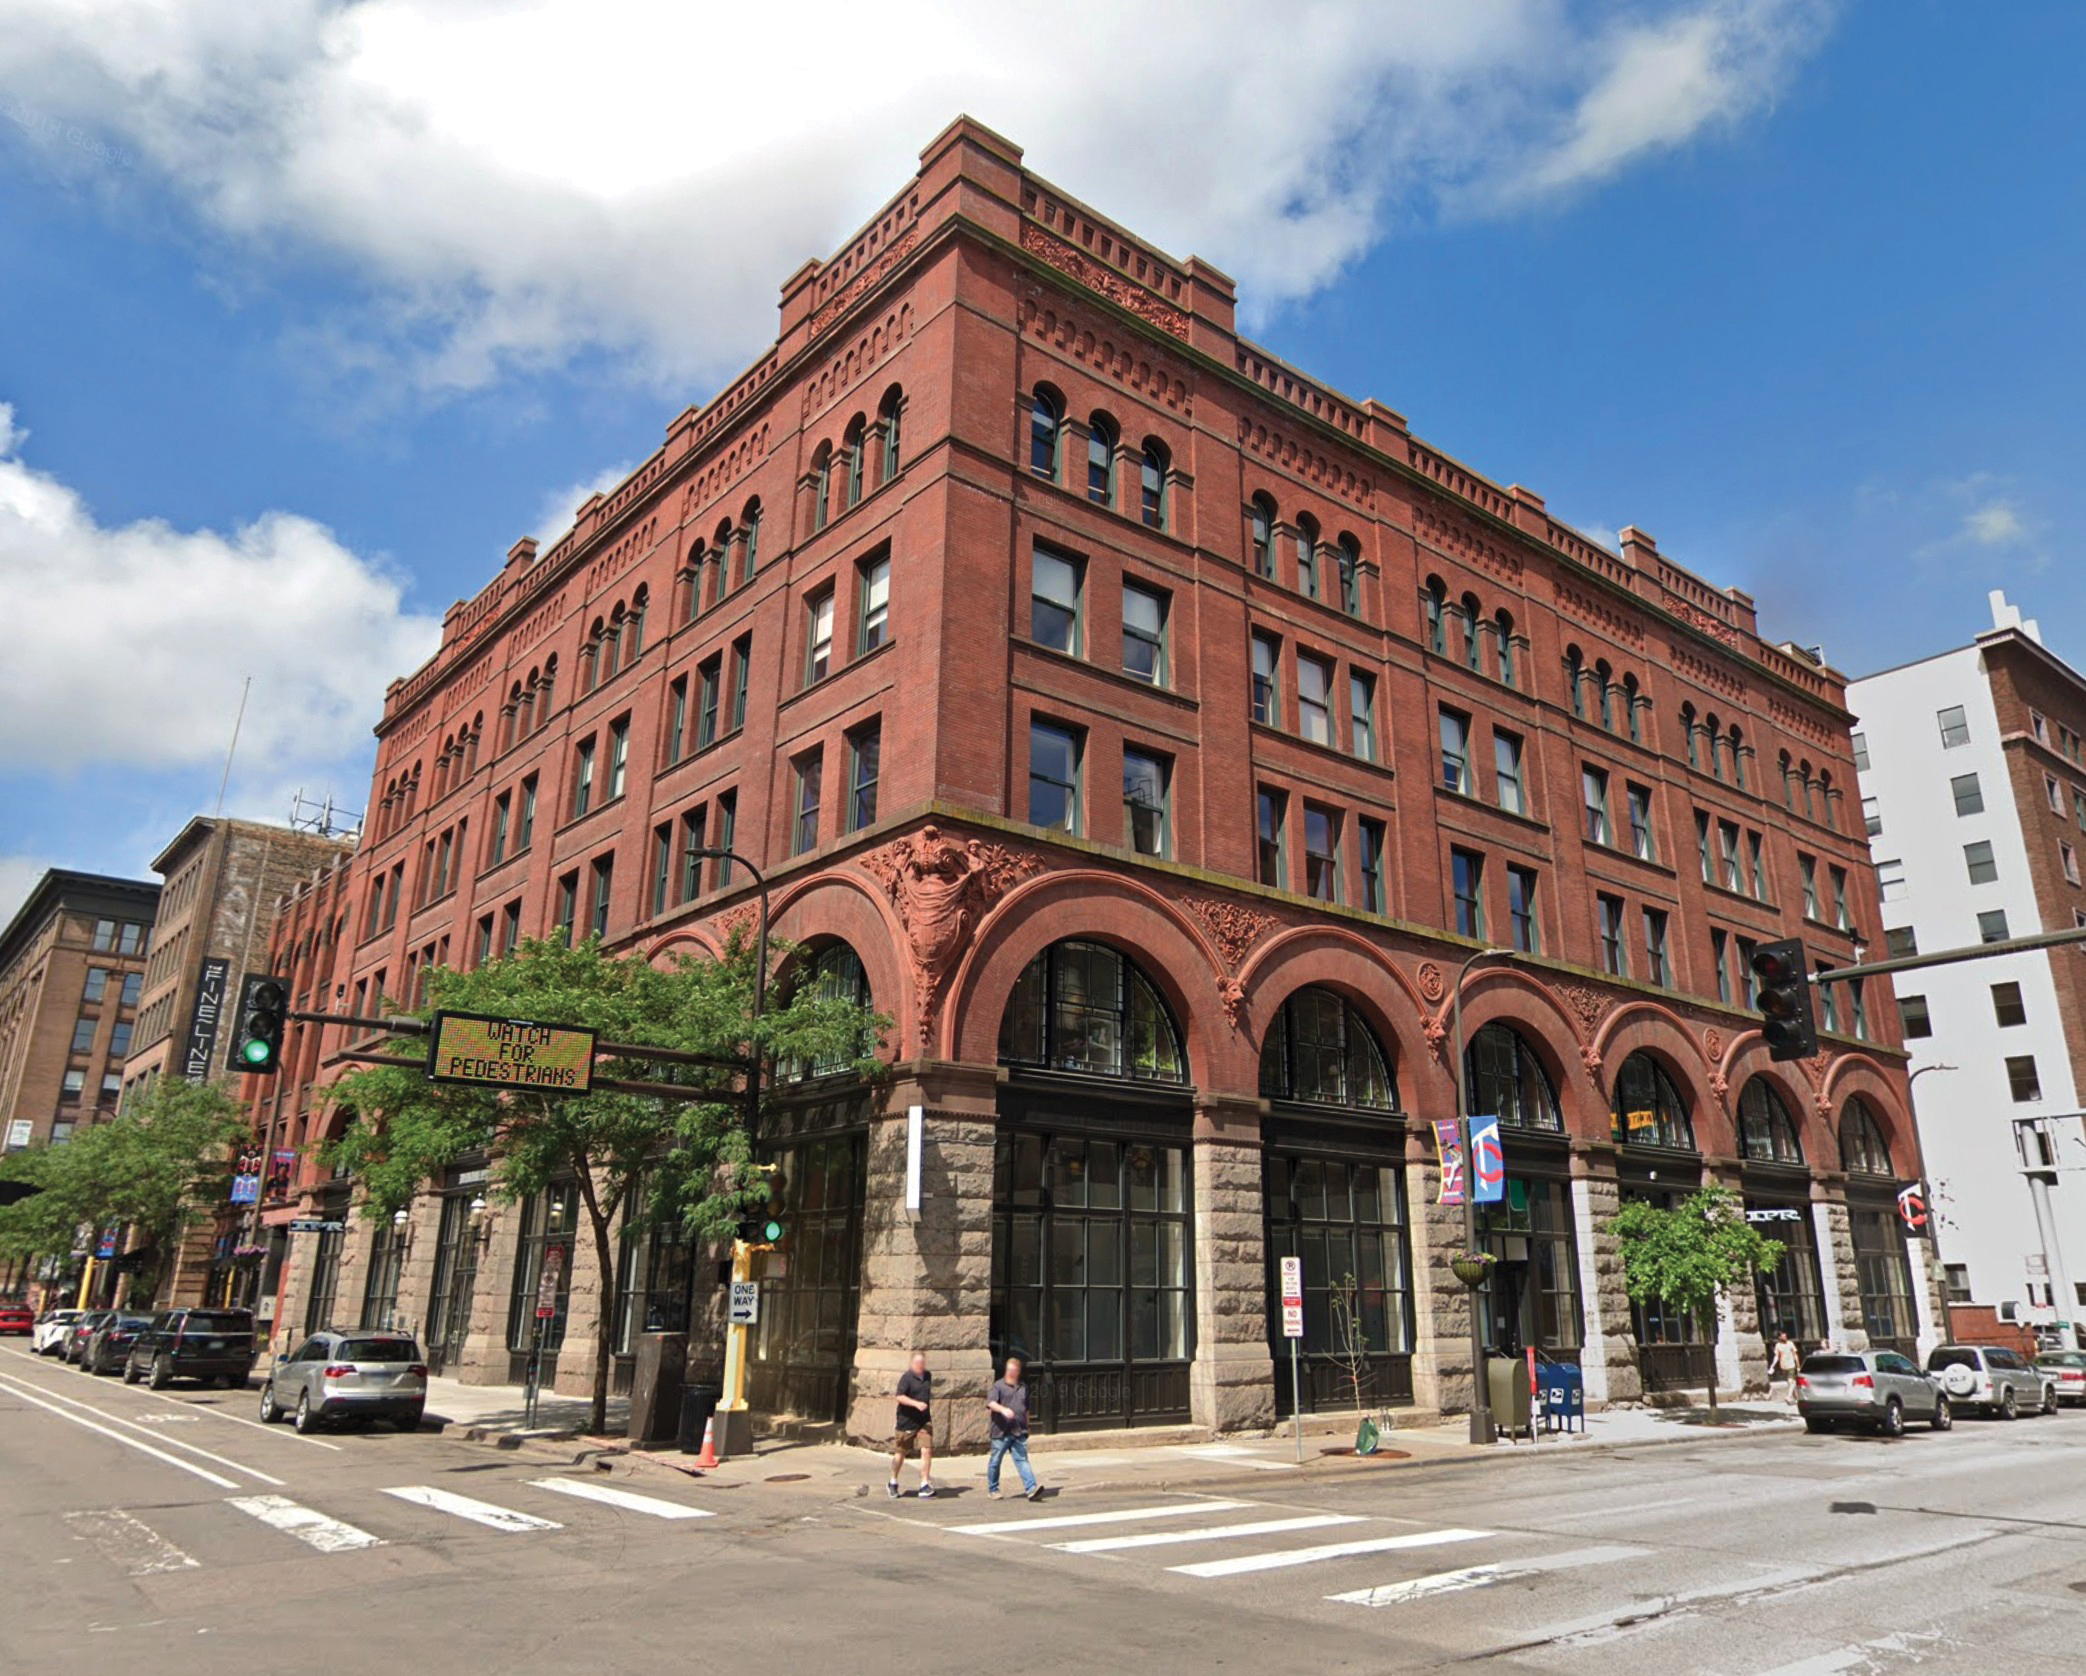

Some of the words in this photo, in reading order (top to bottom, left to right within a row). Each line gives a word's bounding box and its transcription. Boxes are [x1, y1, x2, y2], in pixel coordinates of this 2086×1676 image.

[487, 1022, 550, 1045] WATCH
[500, 1042, 535, 1063] FOR
[450, 1057, 576, 1087] PEDESTRIANS
[734, 1285, 755, 1294] ONE
[734, 1296, 755, 1306] WAY
[1287, 1310, 1297, 1318] NO
